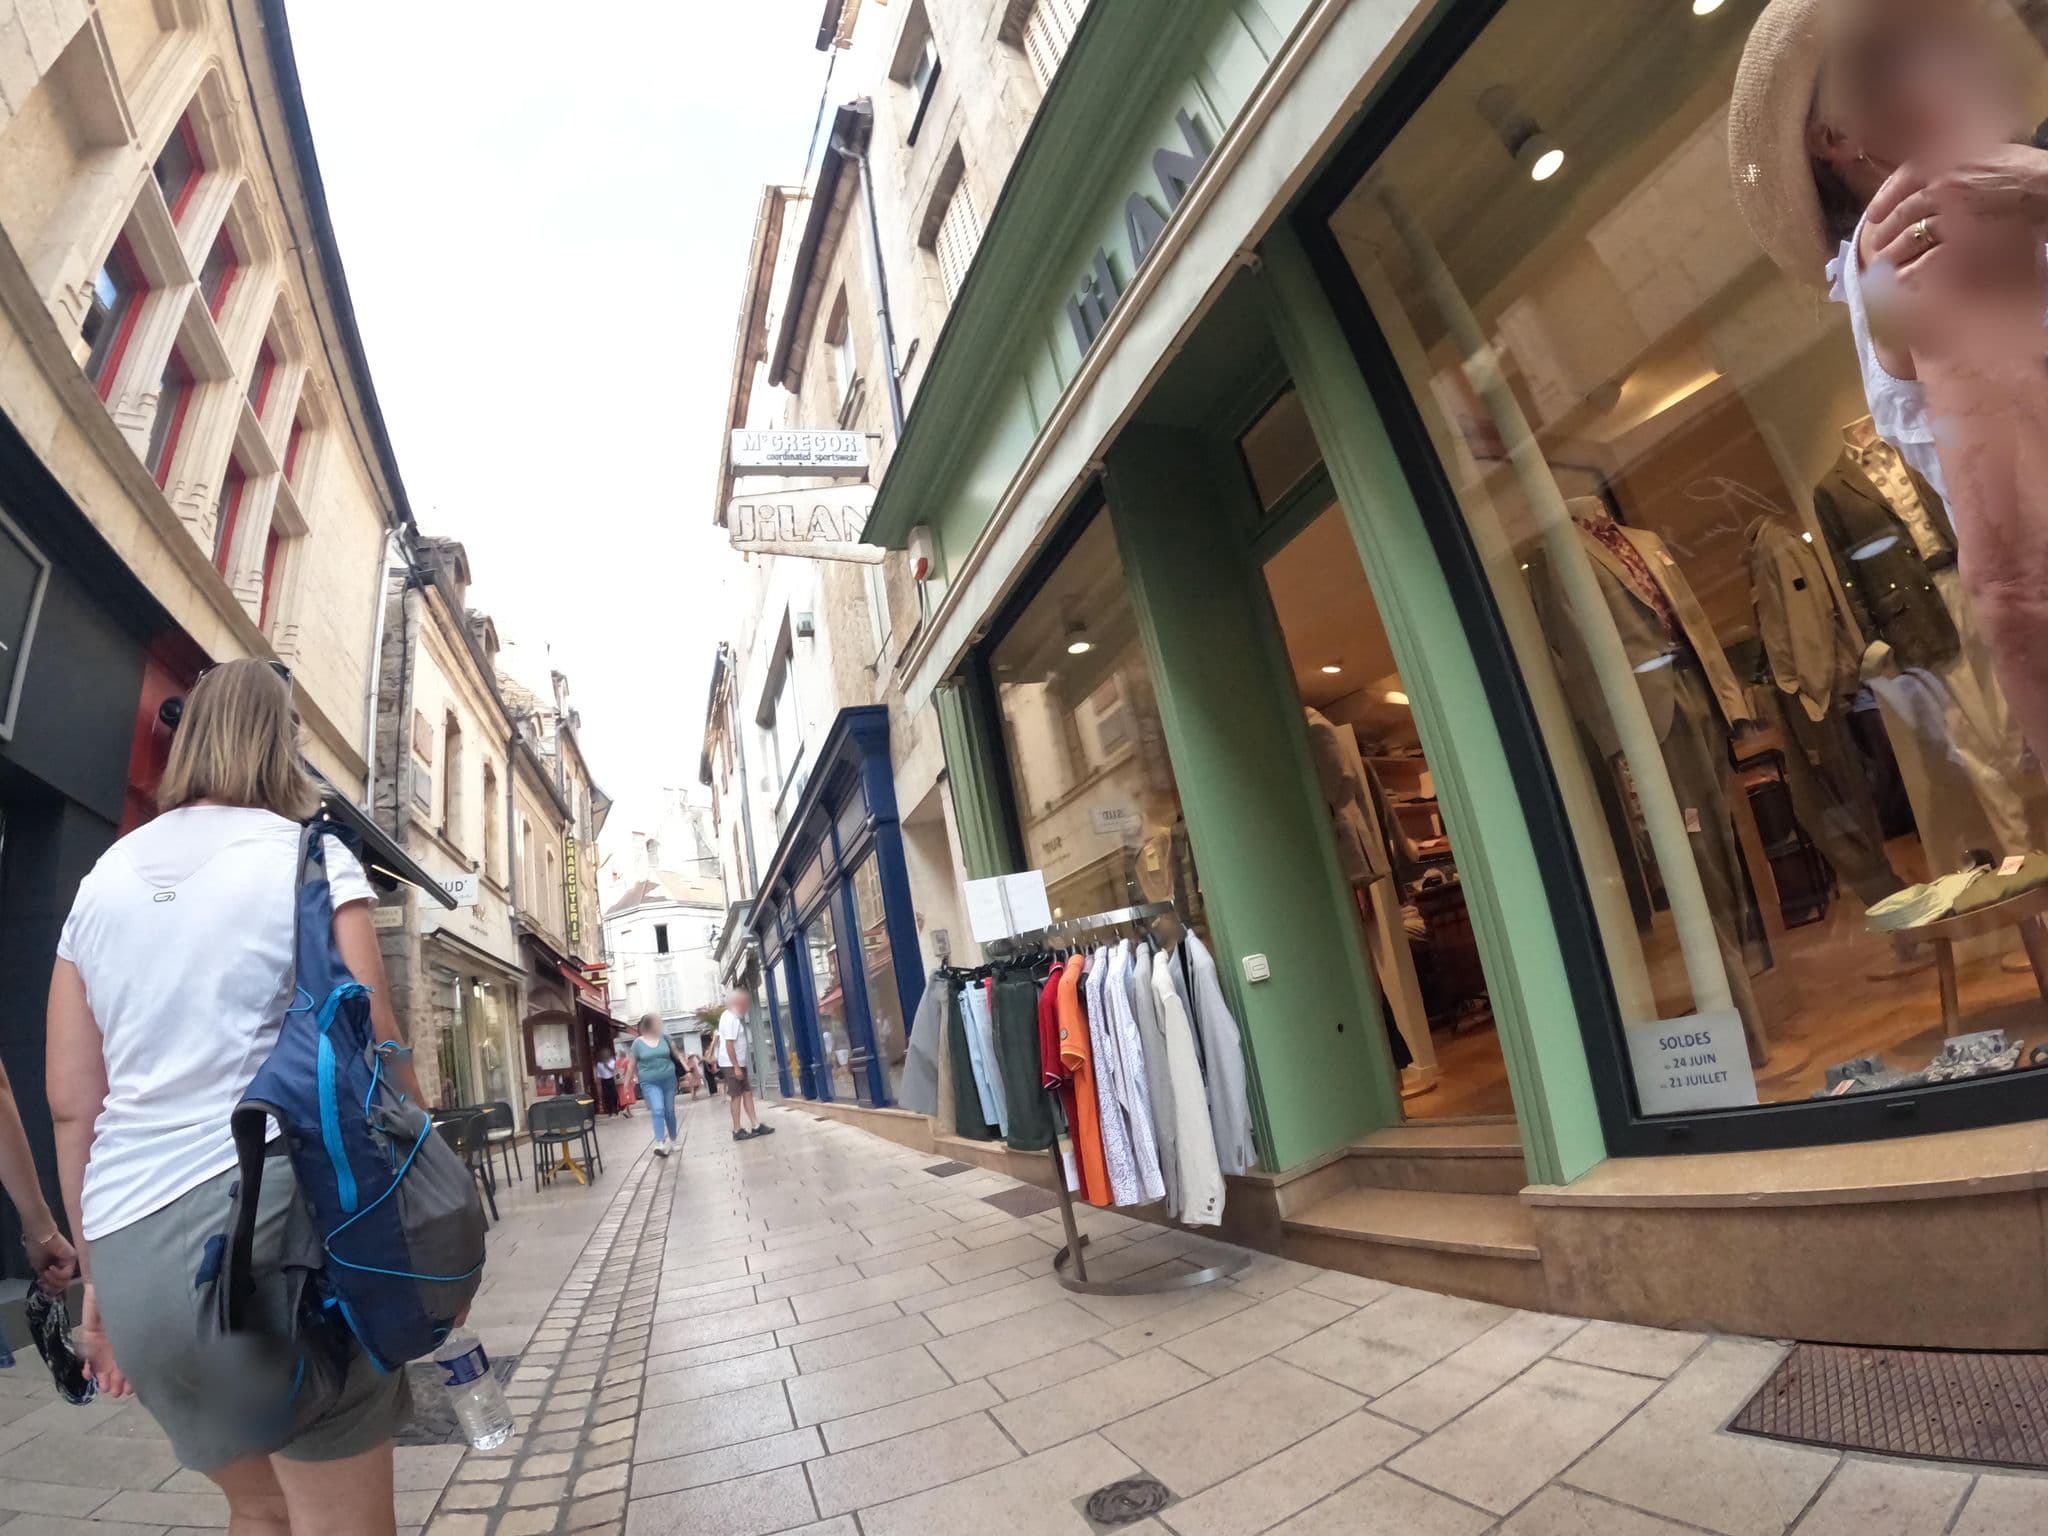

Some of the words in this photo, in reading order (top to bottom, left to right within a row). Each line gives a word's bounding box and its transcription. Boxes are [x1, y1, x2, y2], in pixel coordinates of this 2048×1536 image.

[766, 451, 811, 461] coordinated
[815, 453, 858, 462] sportswear
[566, 838, 579, 941] CHARCUTERIE
[1659, 1031, 1712, 1050] SOLDES
[1673, 1057, 1687, 1068] 24
[1690, 1053, 1717, 1067] JUIN
[1668, 1077, 1683, 1088] 21
[1686, 1070, 1728, 1087] JUILLET
